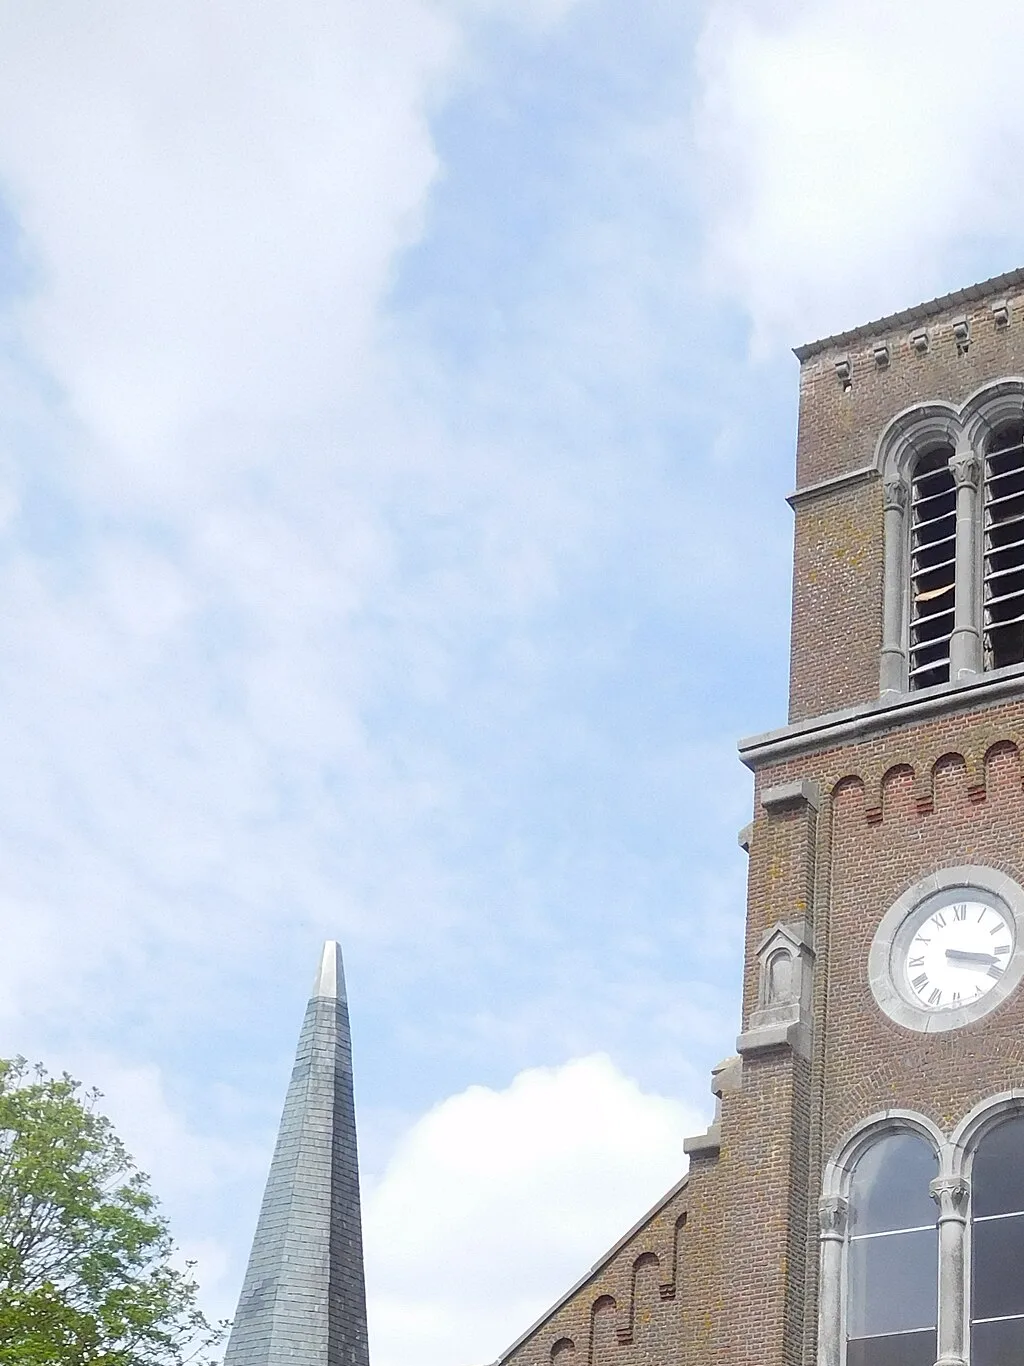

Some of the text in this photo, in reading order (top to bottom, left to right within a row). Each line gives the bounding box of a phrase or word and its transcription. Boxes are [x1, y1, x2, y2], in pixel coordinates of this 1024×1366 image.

[931, 912, 947, 930] XI
[953, 904, 967, 921] XII
[915, 934, 931, 946] X
[908, 955, 925, 968] IX
[928, 987, 943, 1005] VII
